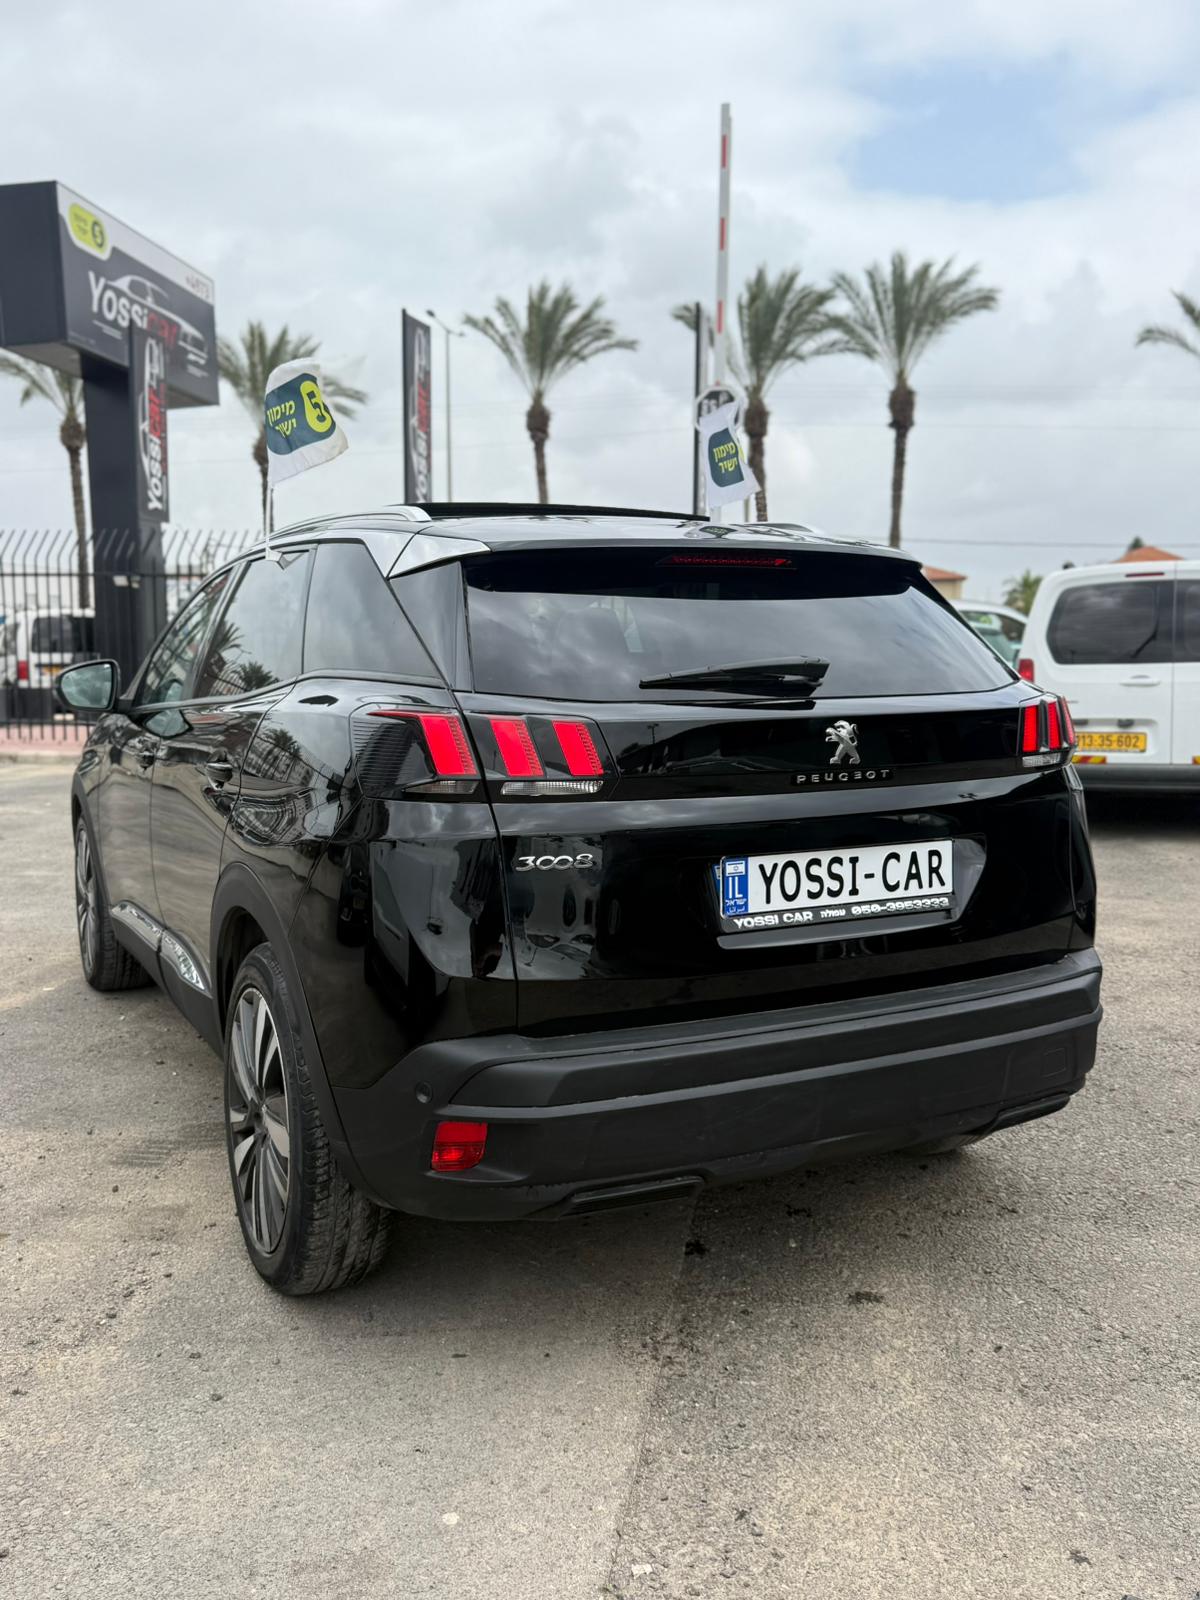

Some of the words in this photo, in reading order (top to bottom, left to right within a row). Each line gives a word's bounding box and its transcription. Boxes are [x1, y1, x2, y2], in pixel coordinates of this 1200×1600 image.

[267, 400, 295, 427] מימון
[713, 441, 736, 463] מימון
[718, 457, 738, 473] ישיר
[796, 769, 890, 784] PEUGEOT
[515, 853, 593, 872] 3008
[758, 849, 946, 905] YOSSI-CAR
[729, 876, 743, 899] IL
[733, 914, 779, 929] YOSSI
[783, 910, 814, 924] CAR
